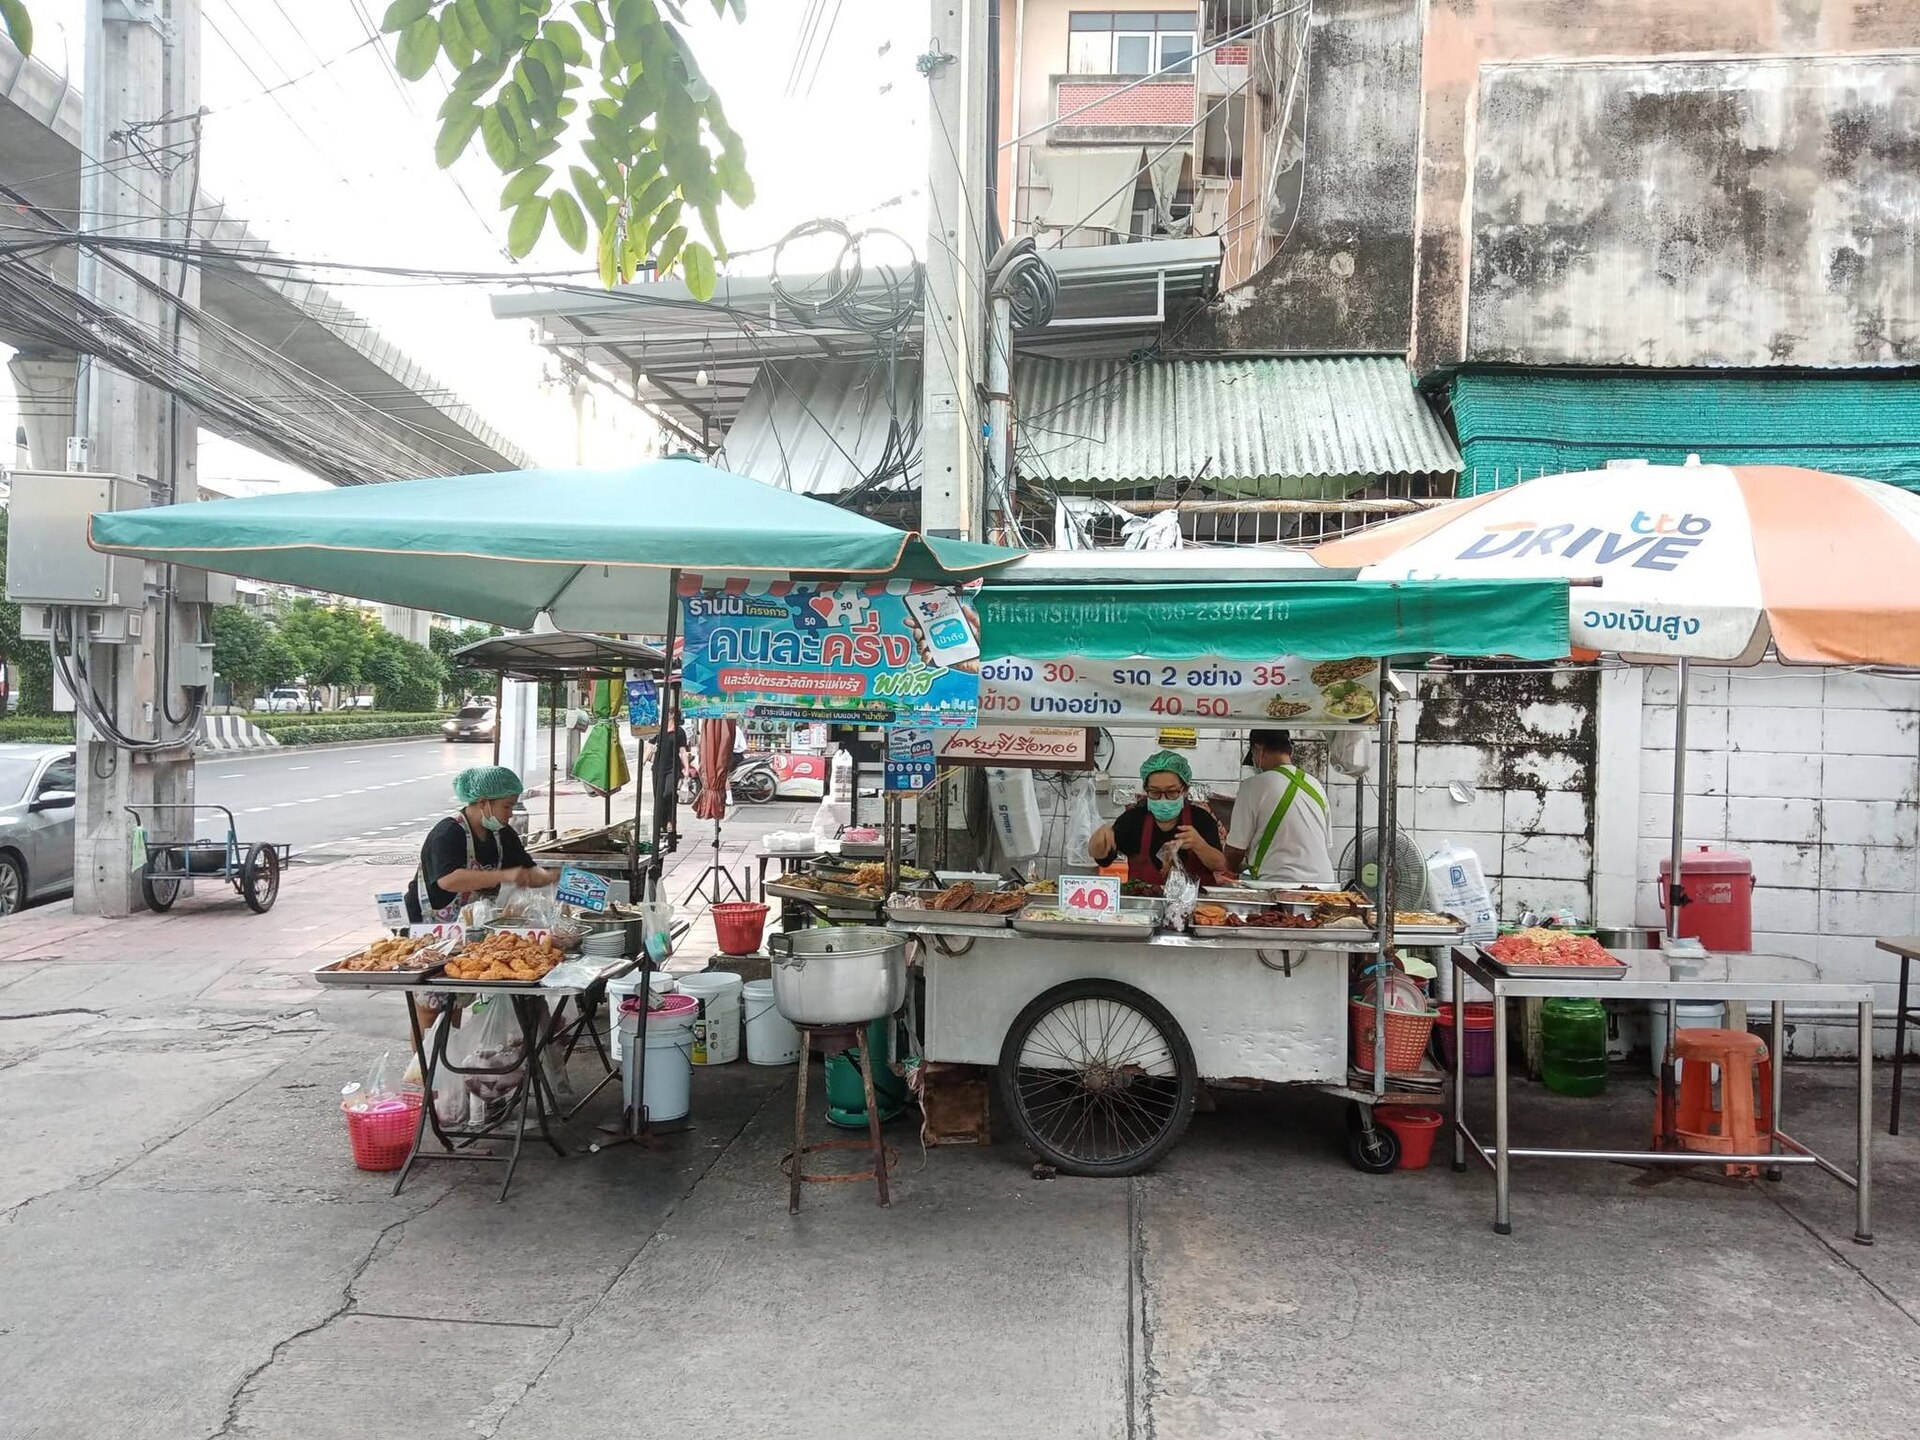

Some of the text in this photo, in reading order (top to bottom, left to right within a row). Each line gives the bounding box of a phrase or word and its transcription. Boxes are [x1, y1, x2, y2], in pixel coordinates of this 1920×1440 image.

[1630, 511, 1712, 536] ttb
[1455, 522, 1704, 571] DRIVE
[840, 602, 853, 611] 50
[804, 617, 816, 626] 50
[1583, 608, 1700, 641] วงเงินสูง
[708, 611, 912, 669] คนละครึ่ง
[723, 672, 861, 692] และรับบัตรสวัสดิการแห่งรัฐ
[873, 662, 948, 696] พลัส
[981, 659, 1300, 686] อย่าง 30.- ราด 2 อย่าง 35.-
[1030, 692, 1122, 714] บางอย่าง
[1069, 888, 1108, 910] 40
